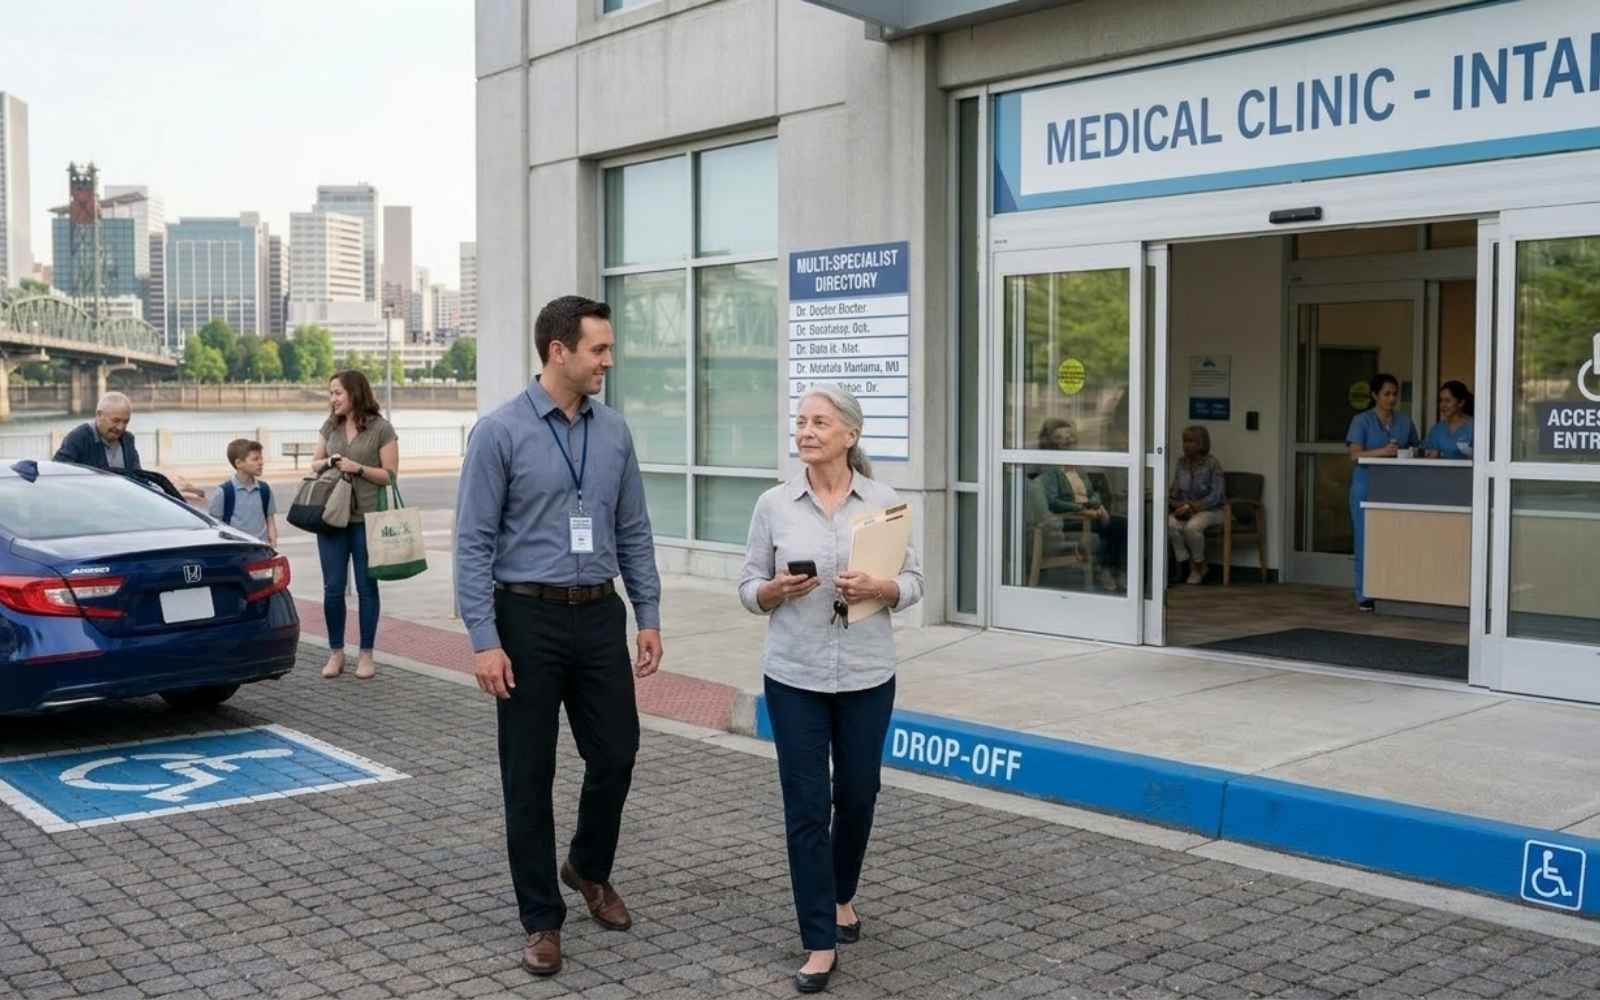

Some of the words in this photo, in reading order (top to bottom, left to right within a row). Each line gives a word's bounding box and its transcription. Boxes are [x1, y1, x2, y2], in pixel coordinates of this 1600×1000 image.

[1047, 97, 1223, 165] MEDICAL
[1238, 67, 1395, 139] CLINIC
[1414, 89, 1430, 99] -
[1453, 32, 1600, 110] INTA
[815, 272, 878, 292] DIRECTORY
[1547, 408, 1600, 427] ACCE
[1553, 431, 1600, 449] ENTR
[892, 728, 1023, 781] DROP-OFF
